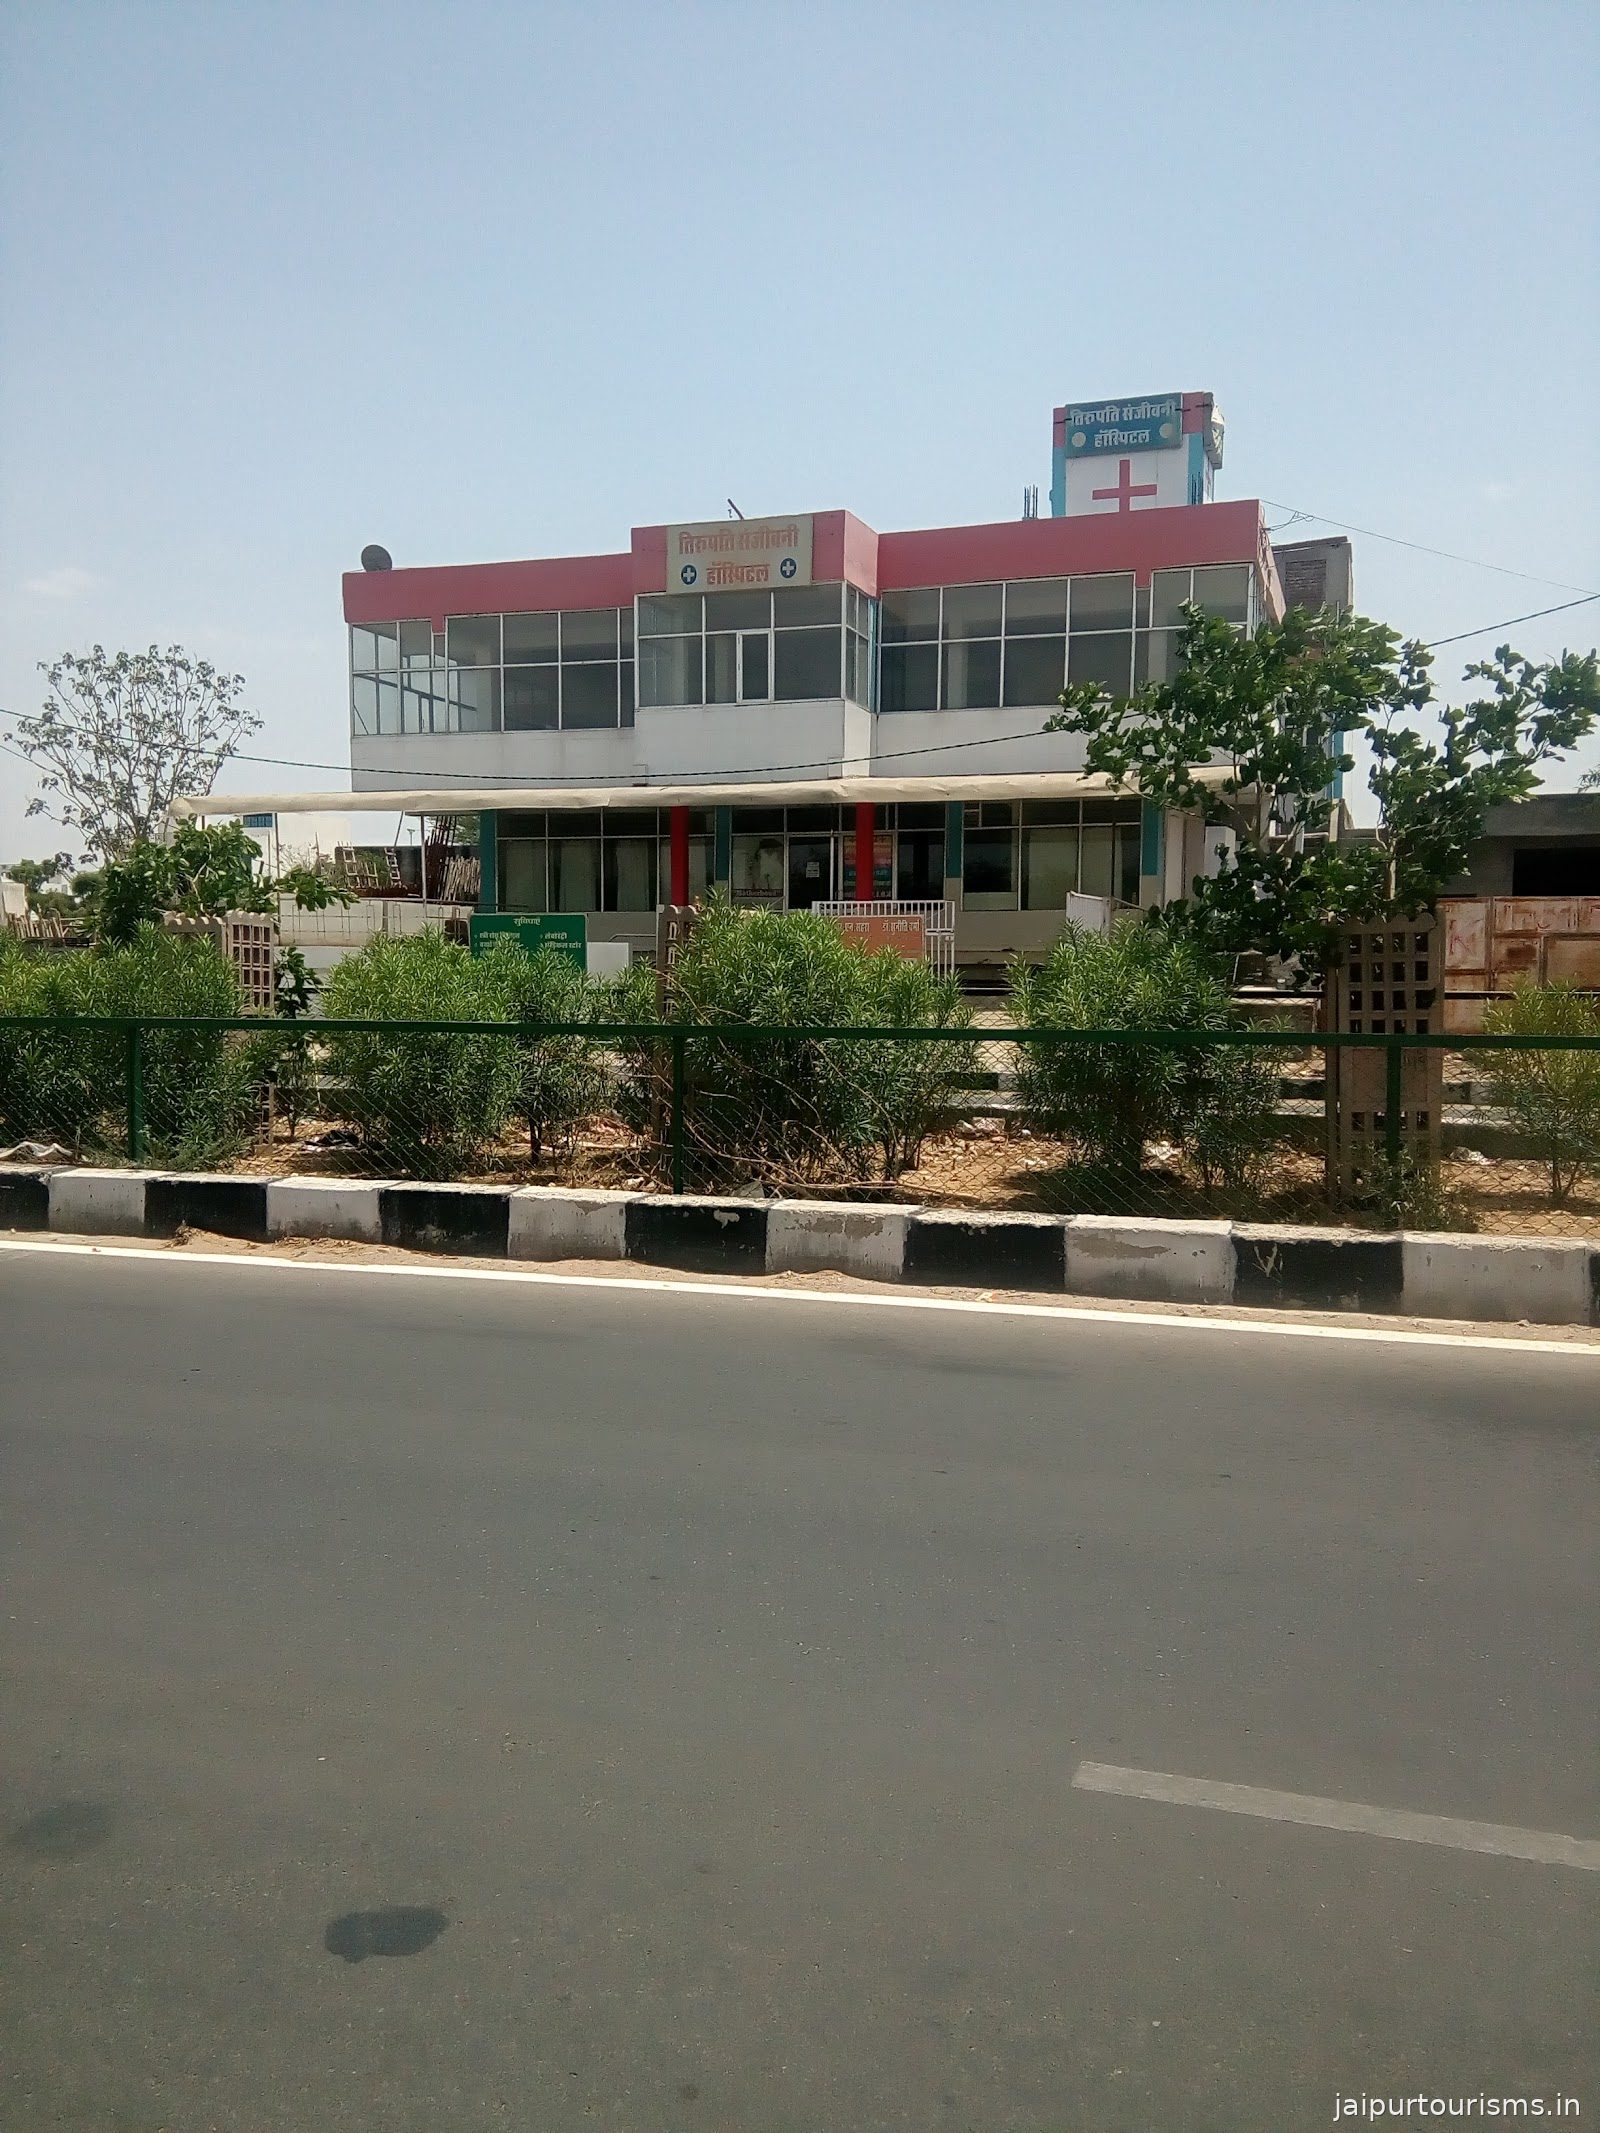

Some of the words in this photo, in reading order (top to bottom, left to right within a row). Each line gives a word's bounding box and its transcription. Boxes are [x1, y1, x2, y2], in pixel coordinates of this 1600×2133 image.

[1070, 405, 1120, 427] तिरुपति
[1122, 400, 1177, 421] संजीवनी
[1094, 428, 1151, 448] हॉस्पिटल
[679, 528, 735, 555] तिरुपति
[740, 523, 799, 550] संजीवनी
[706, 560, 770, 586] हॉस्पिटल
